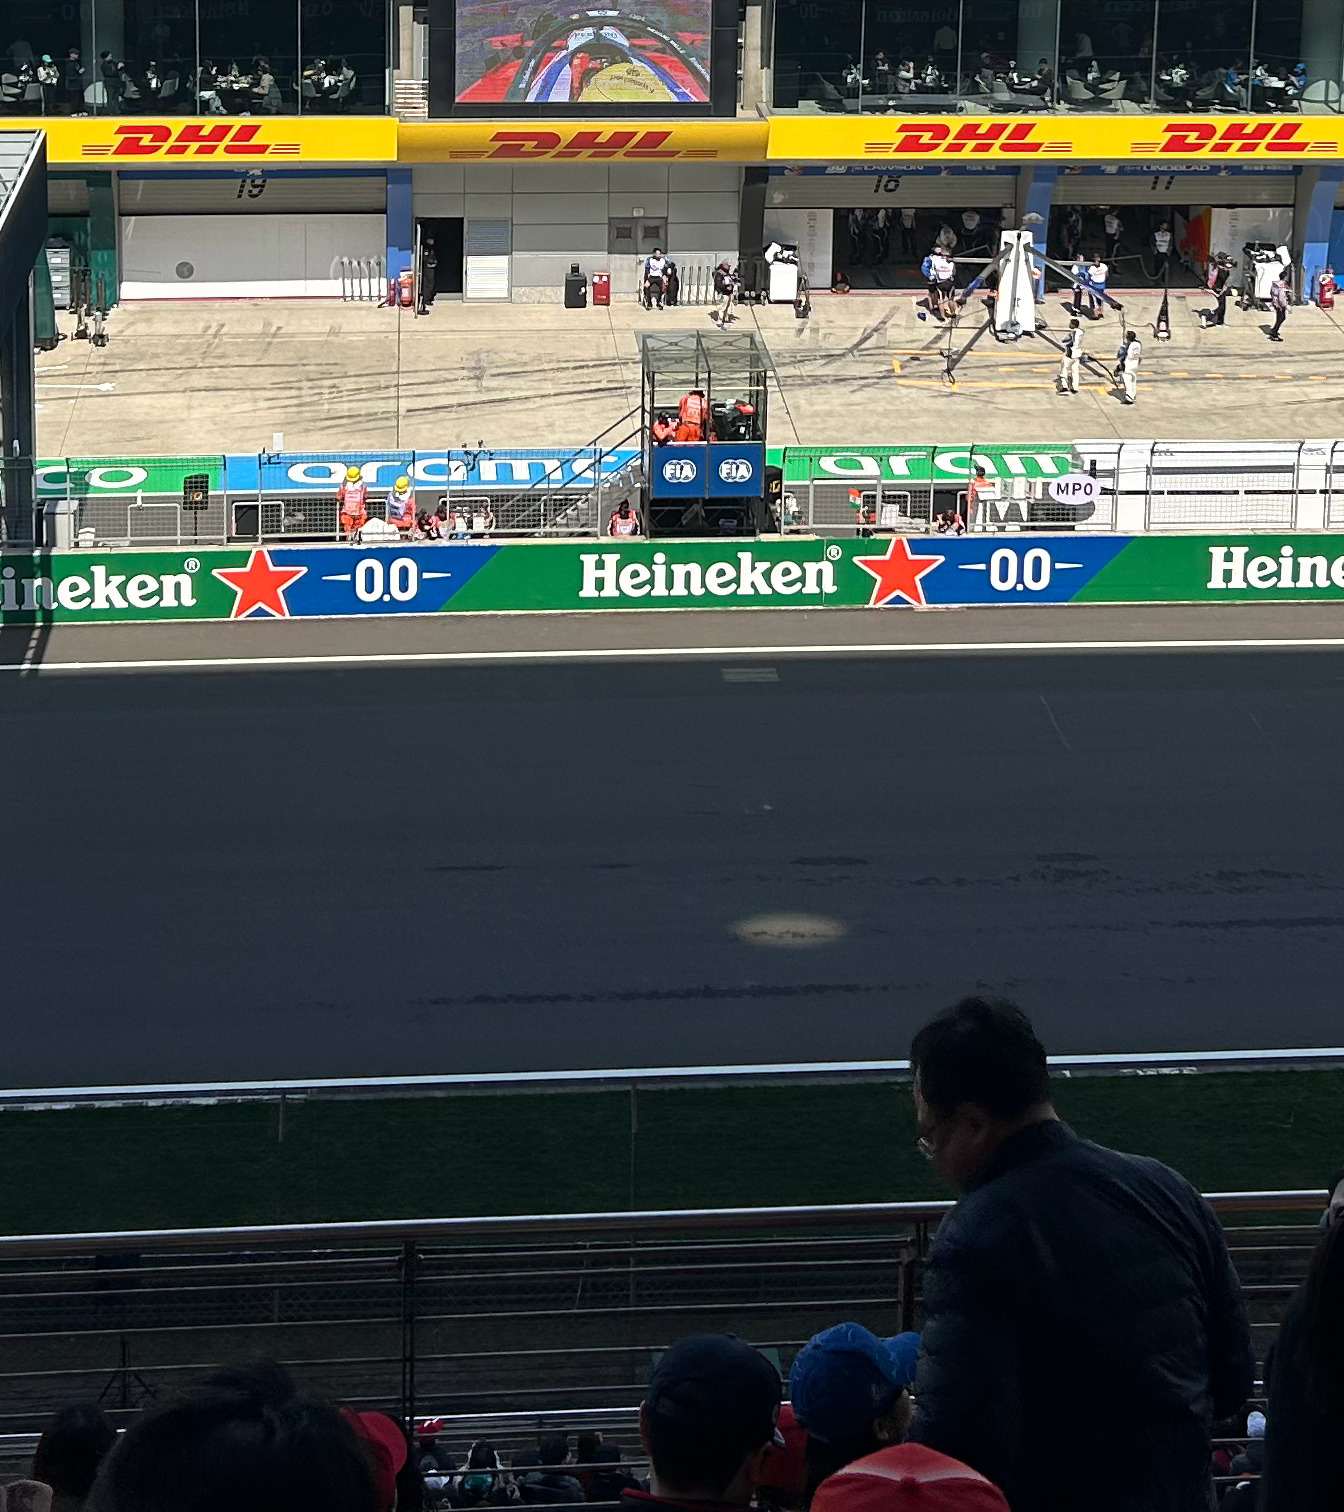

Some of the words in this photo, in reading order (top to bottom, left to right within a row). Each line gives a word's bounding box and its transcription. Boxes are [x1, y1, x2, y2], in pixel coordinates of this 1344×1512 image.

[113, 124, 273, 156] DHL
[488, 130, 680, 158] DHL
[892, 122, 1045, 152] DHL
[1158, 122, 1310, 152] DHL
[236, 178, 267, 199] 19
[664, 463, 695, 479] FIA
[720, 463, 751, 479] FIA
[354, 557, 419, 603] 0.0
[989, 548, 1052, 592] 0.0
